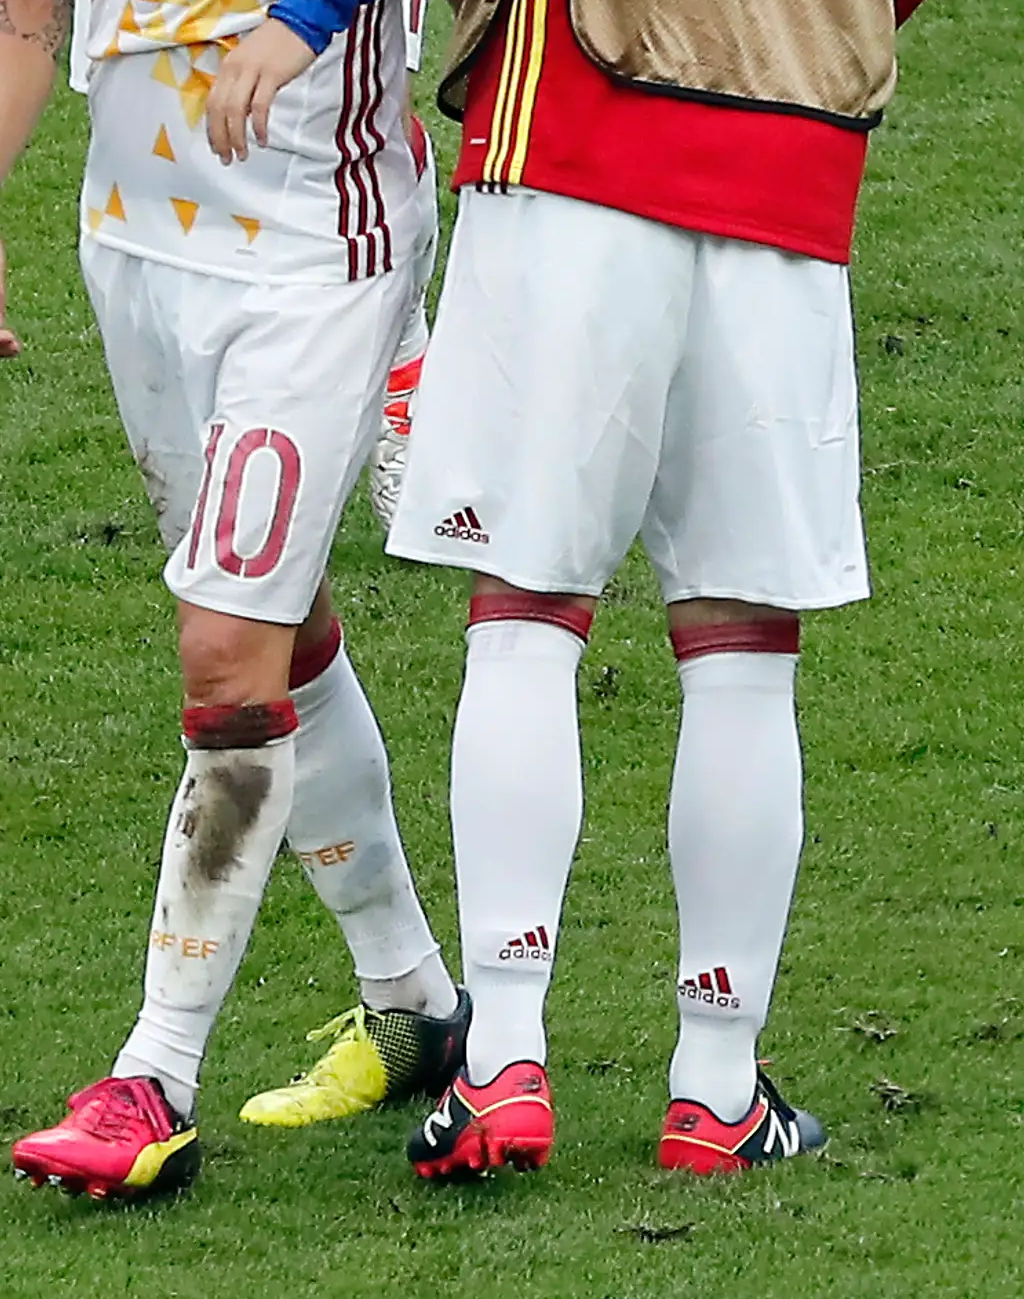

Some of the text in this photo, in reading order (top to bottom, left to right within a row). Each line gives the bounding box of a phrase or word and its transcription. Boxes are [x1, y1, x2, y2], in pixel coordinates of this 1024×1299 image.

[187, 421, 303, 580] 10
[434, 525, 489, 544] adidas
[678, 984, 740, 1009] adidas
